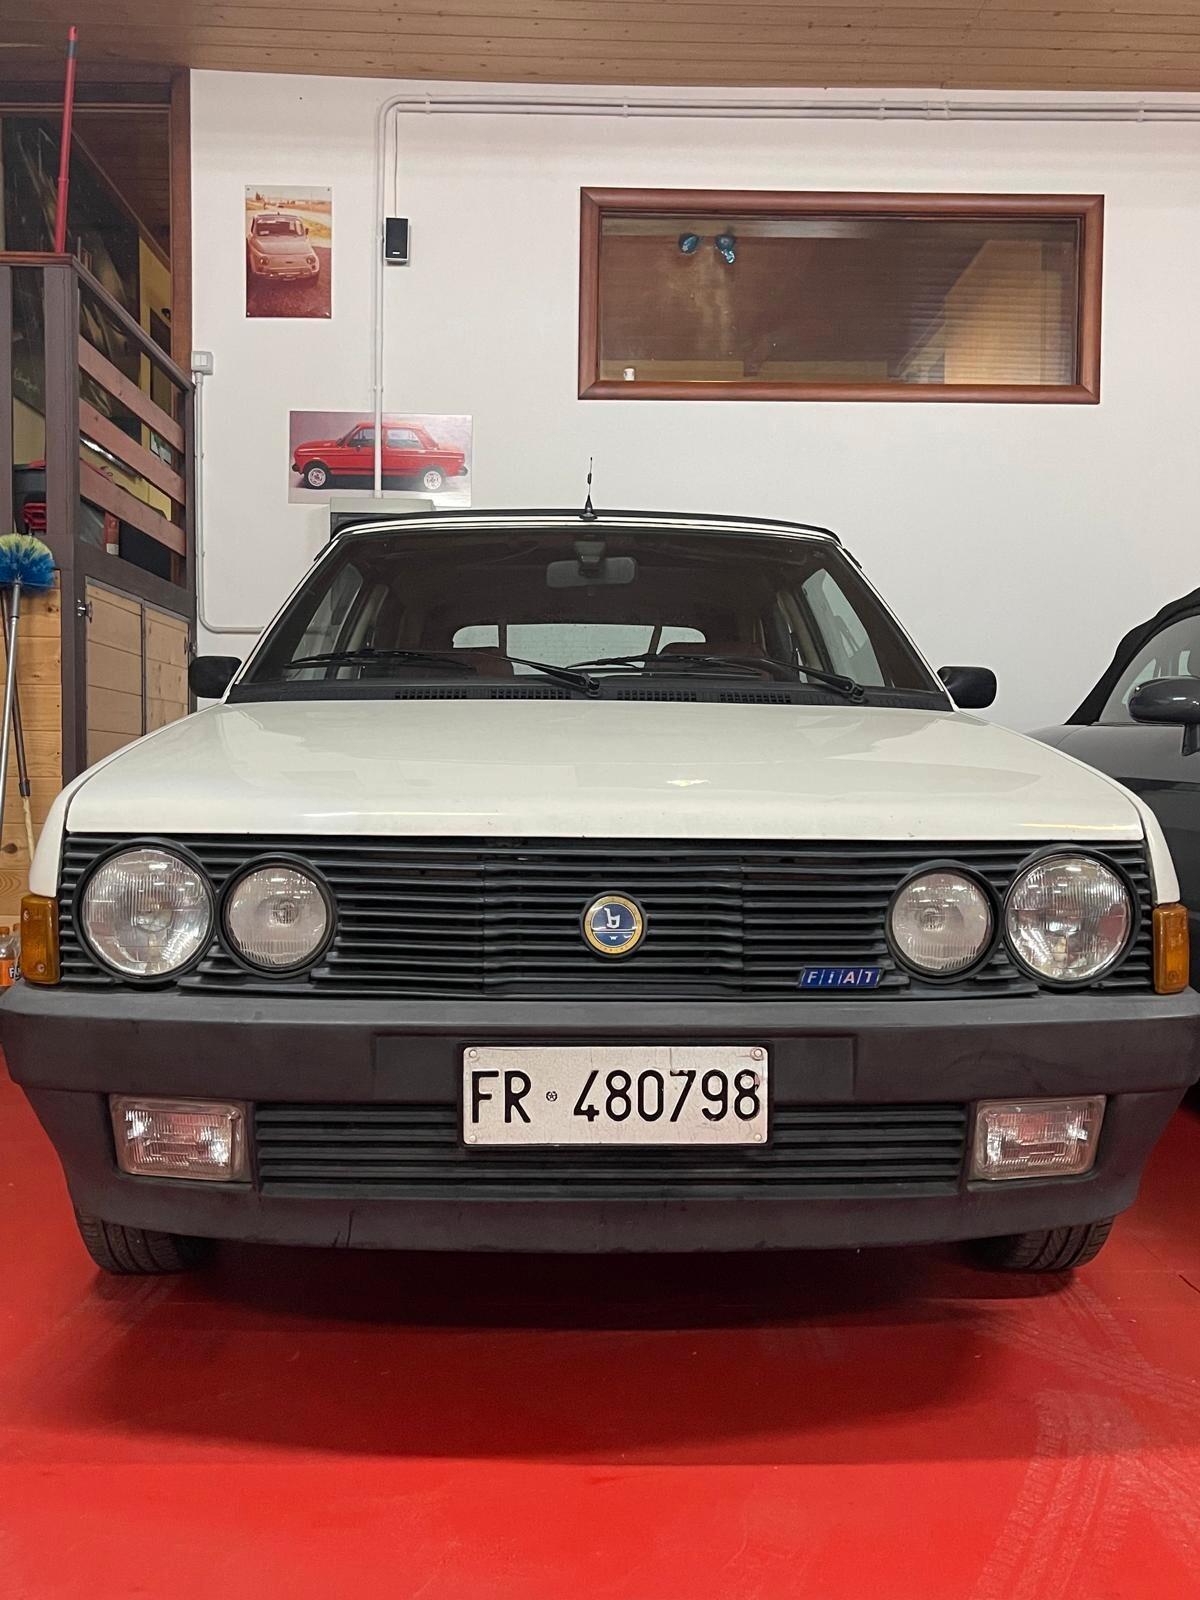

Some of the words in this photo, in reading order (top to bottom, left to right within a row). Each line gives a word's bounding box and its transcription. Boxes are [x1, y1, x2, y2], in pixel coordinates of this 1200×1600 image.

[807, 971, 874, 984] FIAT
[471, 1070, 532, 1123] FR
[573, 1069, 761, 1122] 480798
